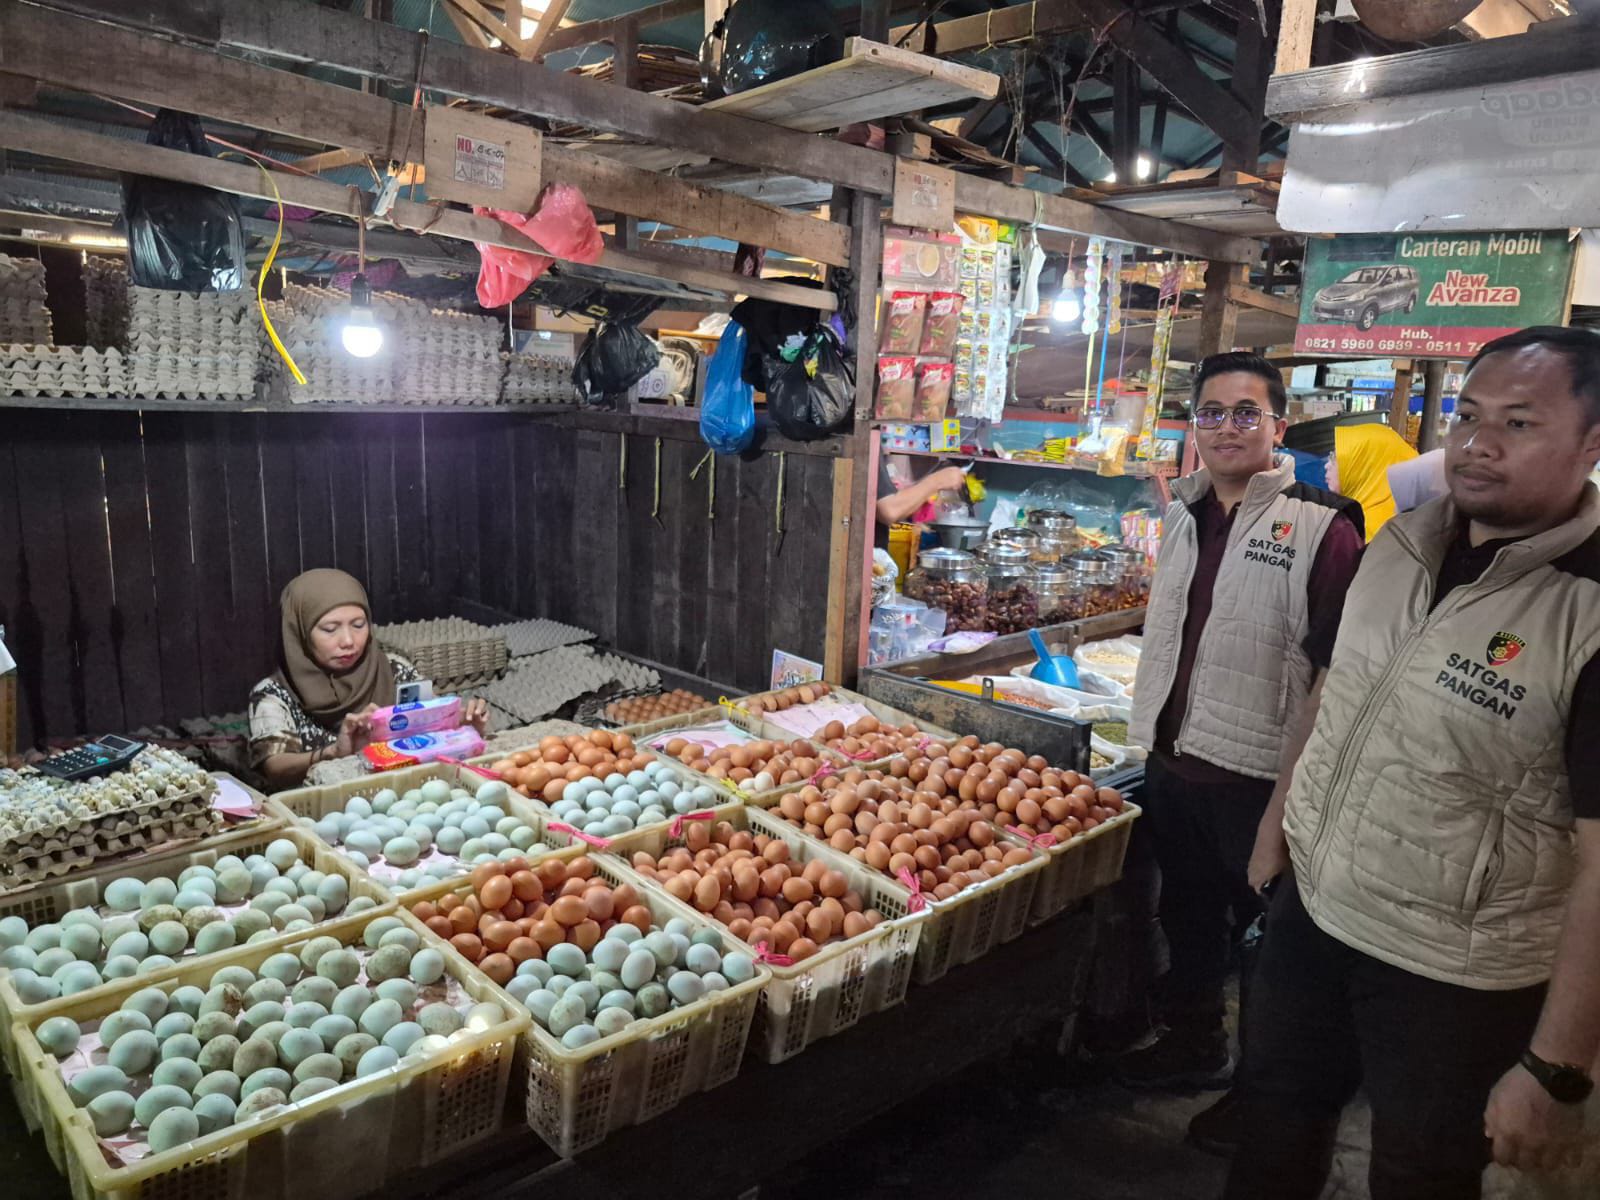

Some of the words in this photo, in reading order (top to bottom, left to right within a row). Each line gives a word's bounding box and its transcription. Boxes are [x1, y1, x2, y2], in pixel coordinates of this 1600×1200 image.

[1401, 236, 1480, 257] Carteran
[1487, 232, 1542, 256] Mobil
[1446, 271, 1487, 288] New
[1428, 283, 1519, 303] Avanza
[1400, 329, 1433, 340] Hub.
[1305, 338, 1335, 349] 0821
[1341, 338, 1374, 350] 5960
[1426, 341, 1461, 352] 0511
[1248, 538, 1297, 559] SATGAS
[1446, 653, 1527, 702] SATGAS
[1435, 670, 1516, 720] PANGAN
